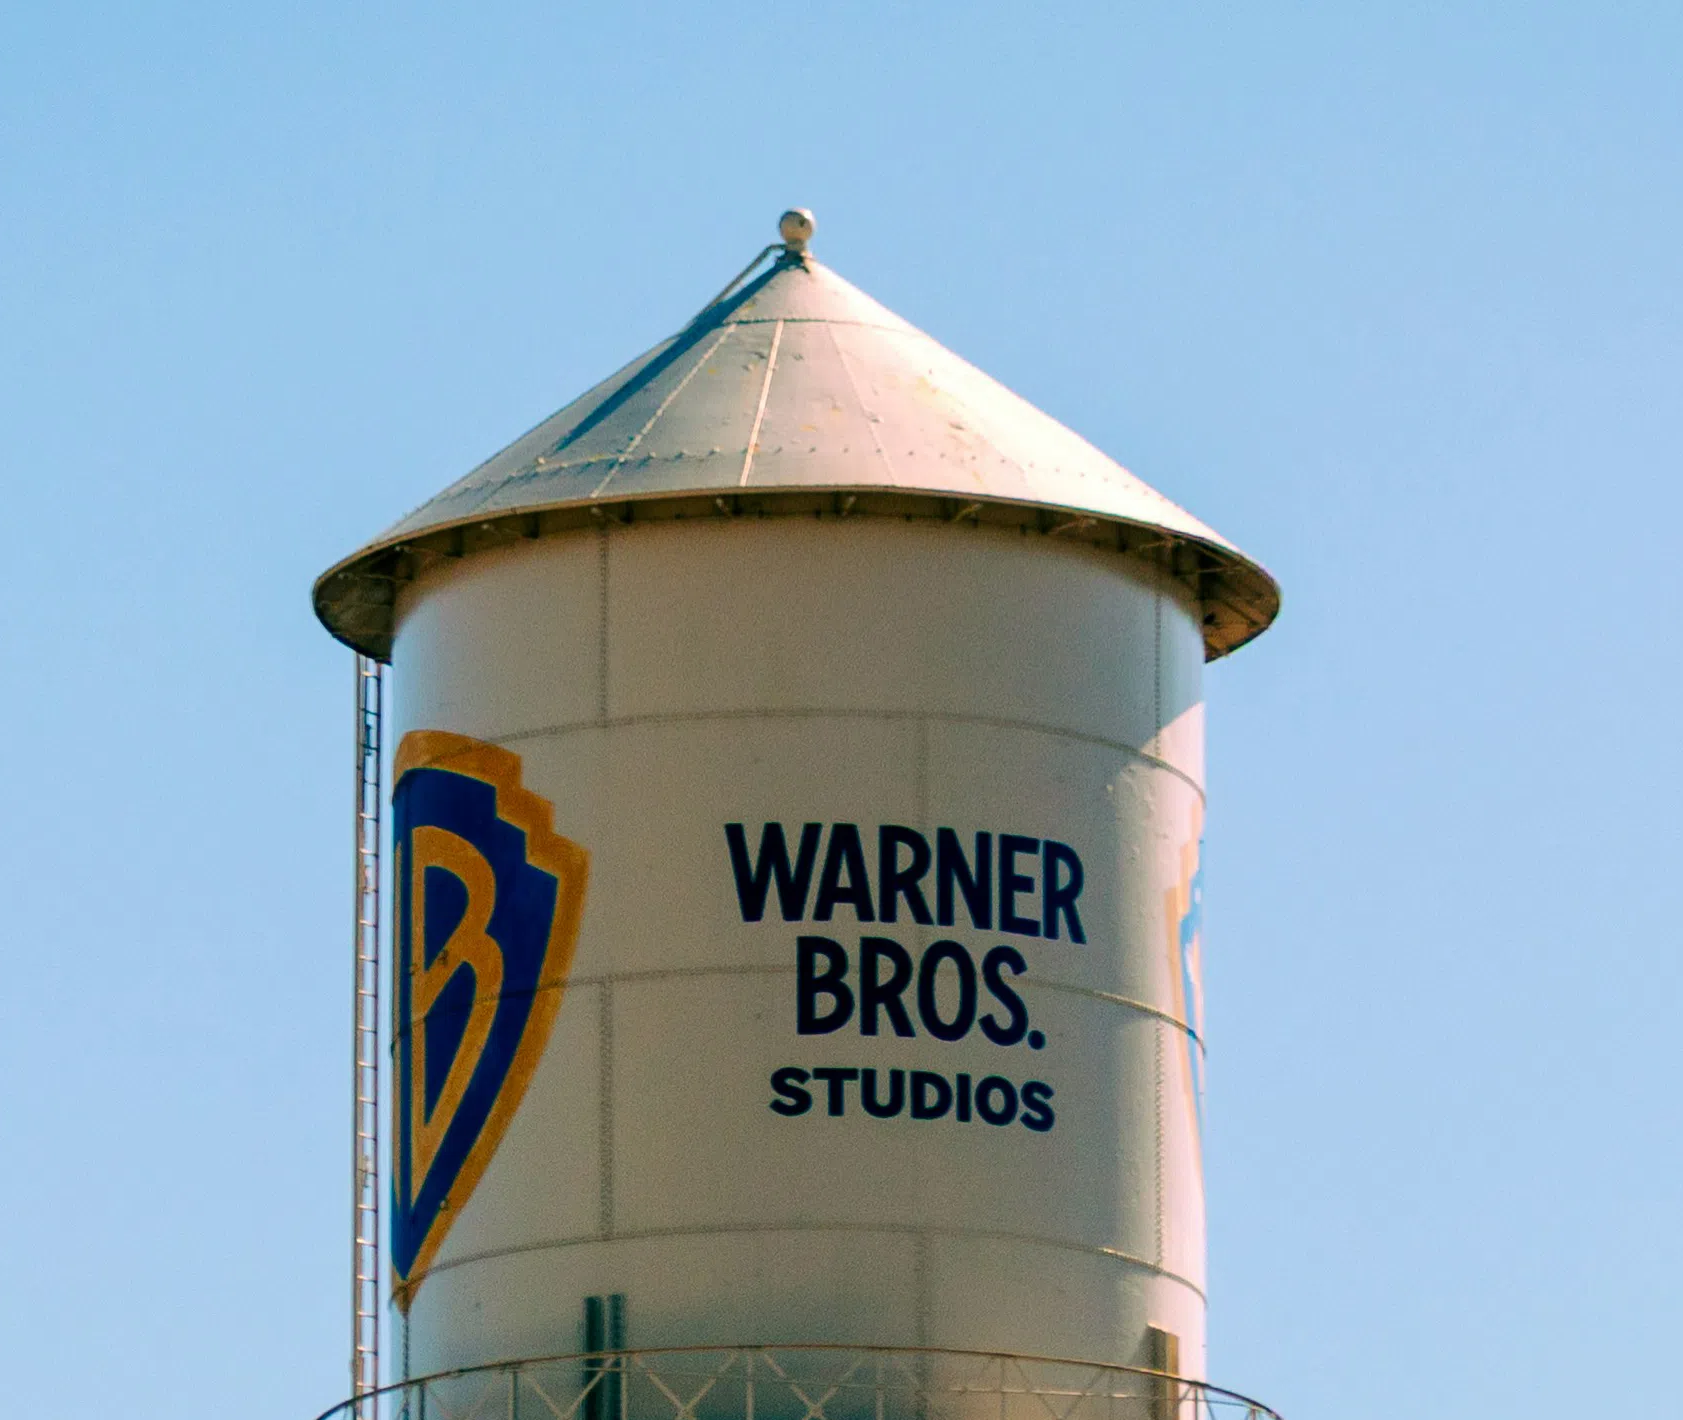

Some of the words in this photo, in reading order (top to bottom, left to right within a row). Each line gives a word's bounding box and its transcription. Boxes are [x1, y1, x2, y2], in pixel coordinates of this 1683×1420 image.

[724, 822, 1087, 945] WARNER
[796, 935, 1047, 1051] BROS.
[769, 1066, 1056, 1132] STUDIOS
